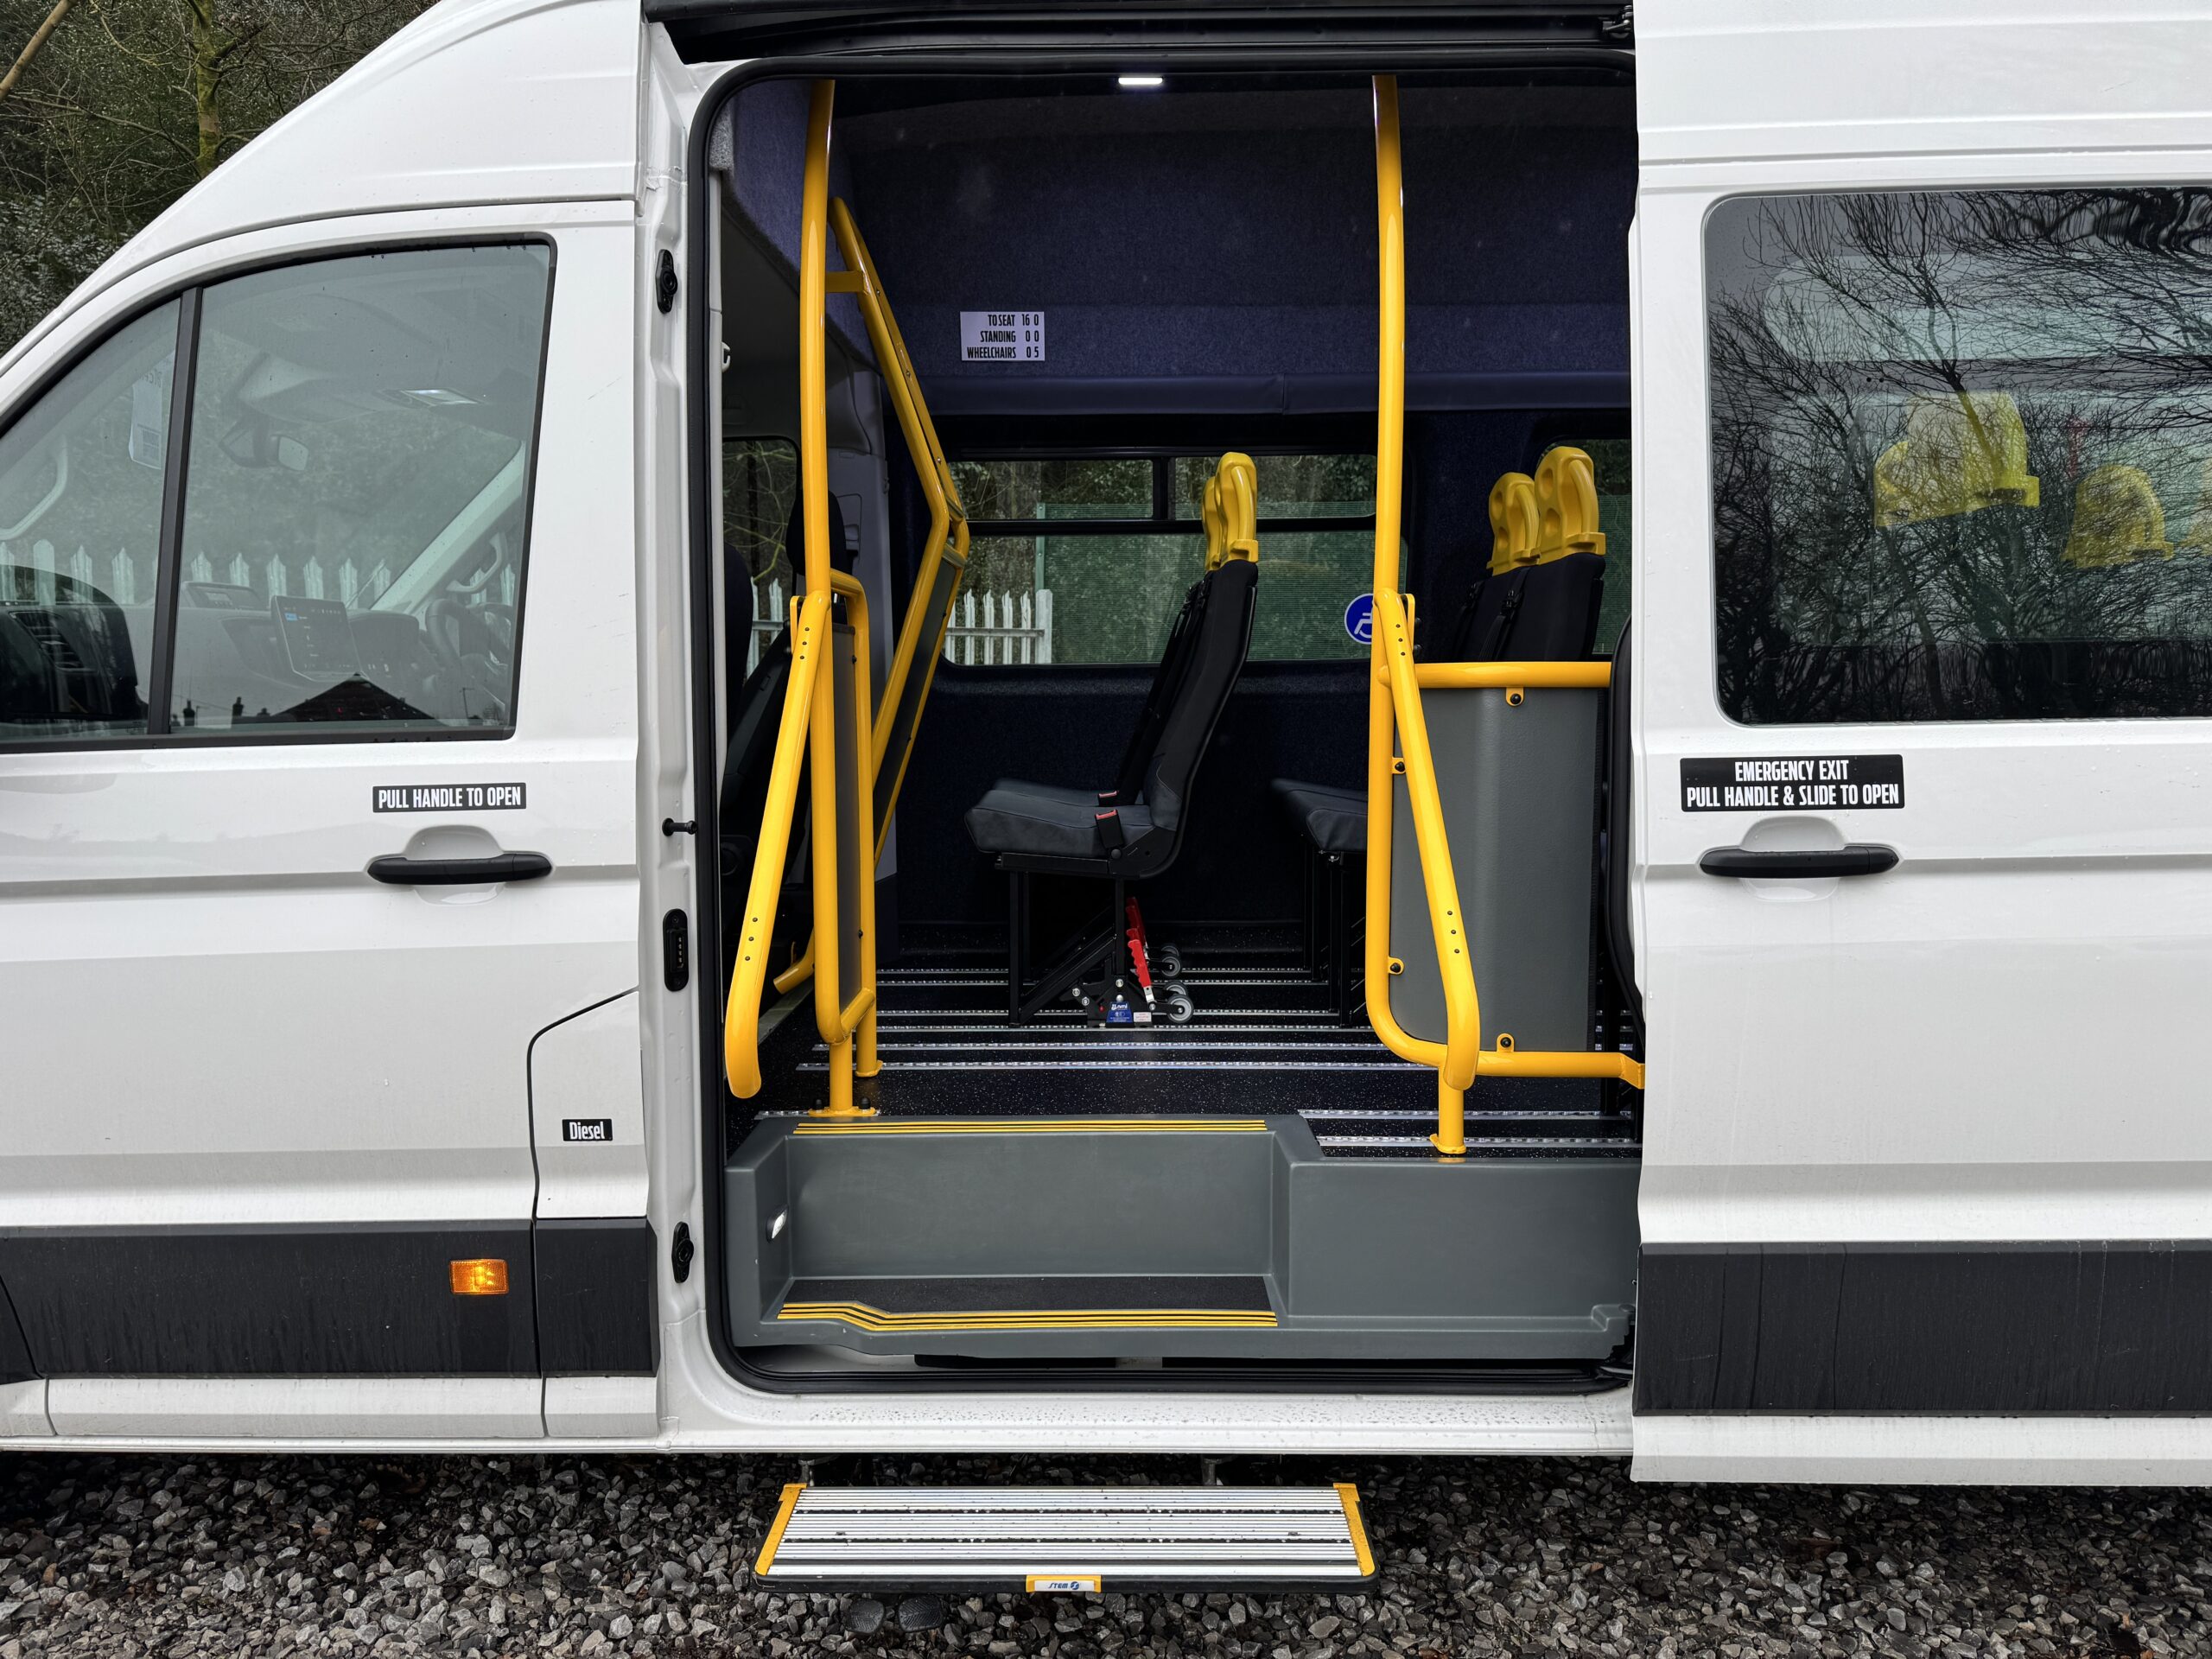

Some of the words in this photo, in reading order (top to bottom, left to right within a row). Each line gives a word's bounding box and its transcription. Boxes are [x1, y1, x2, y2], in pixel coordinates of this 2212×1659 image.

[988, 314, 998, 327] TO
[998, 314, 1015, 327] SEAT
[1021, 314, 1030, 326] 16
[1033, 314, 1039, 326] 0
[980, 330, 1016, 343] STANDING
[1025, 330, 1031, 342] 0
[1034, 330, 1039, 342] 0
[967, 346, 1016, 359] WHEELCHAIRS
[1026, 346, 1032, 359] 0
[1034, 346, 1039, 358] 5
[1734, 760, 1815, 782] EMERGENCY
[1819, 760, 1849, 780] EXIT
[378, 789, 409, 809] PULL
[412, 787, 463, 808] HANDLE
[467, 787, 483, 807] TO
[486, 786, 521, 806] OPEN
[1687, 786, 1720, 807] PULL
[1724, 785, 1779, 807] HANDLE
[1783, 785, 1795, 806] &
[1798, 785, 1837, 805] SLIDE
[1840, 784, 1858, 804] TO
[1862, 784, 1899, 804] OPEN
[569, 1121, 606, 1140] Diesel
